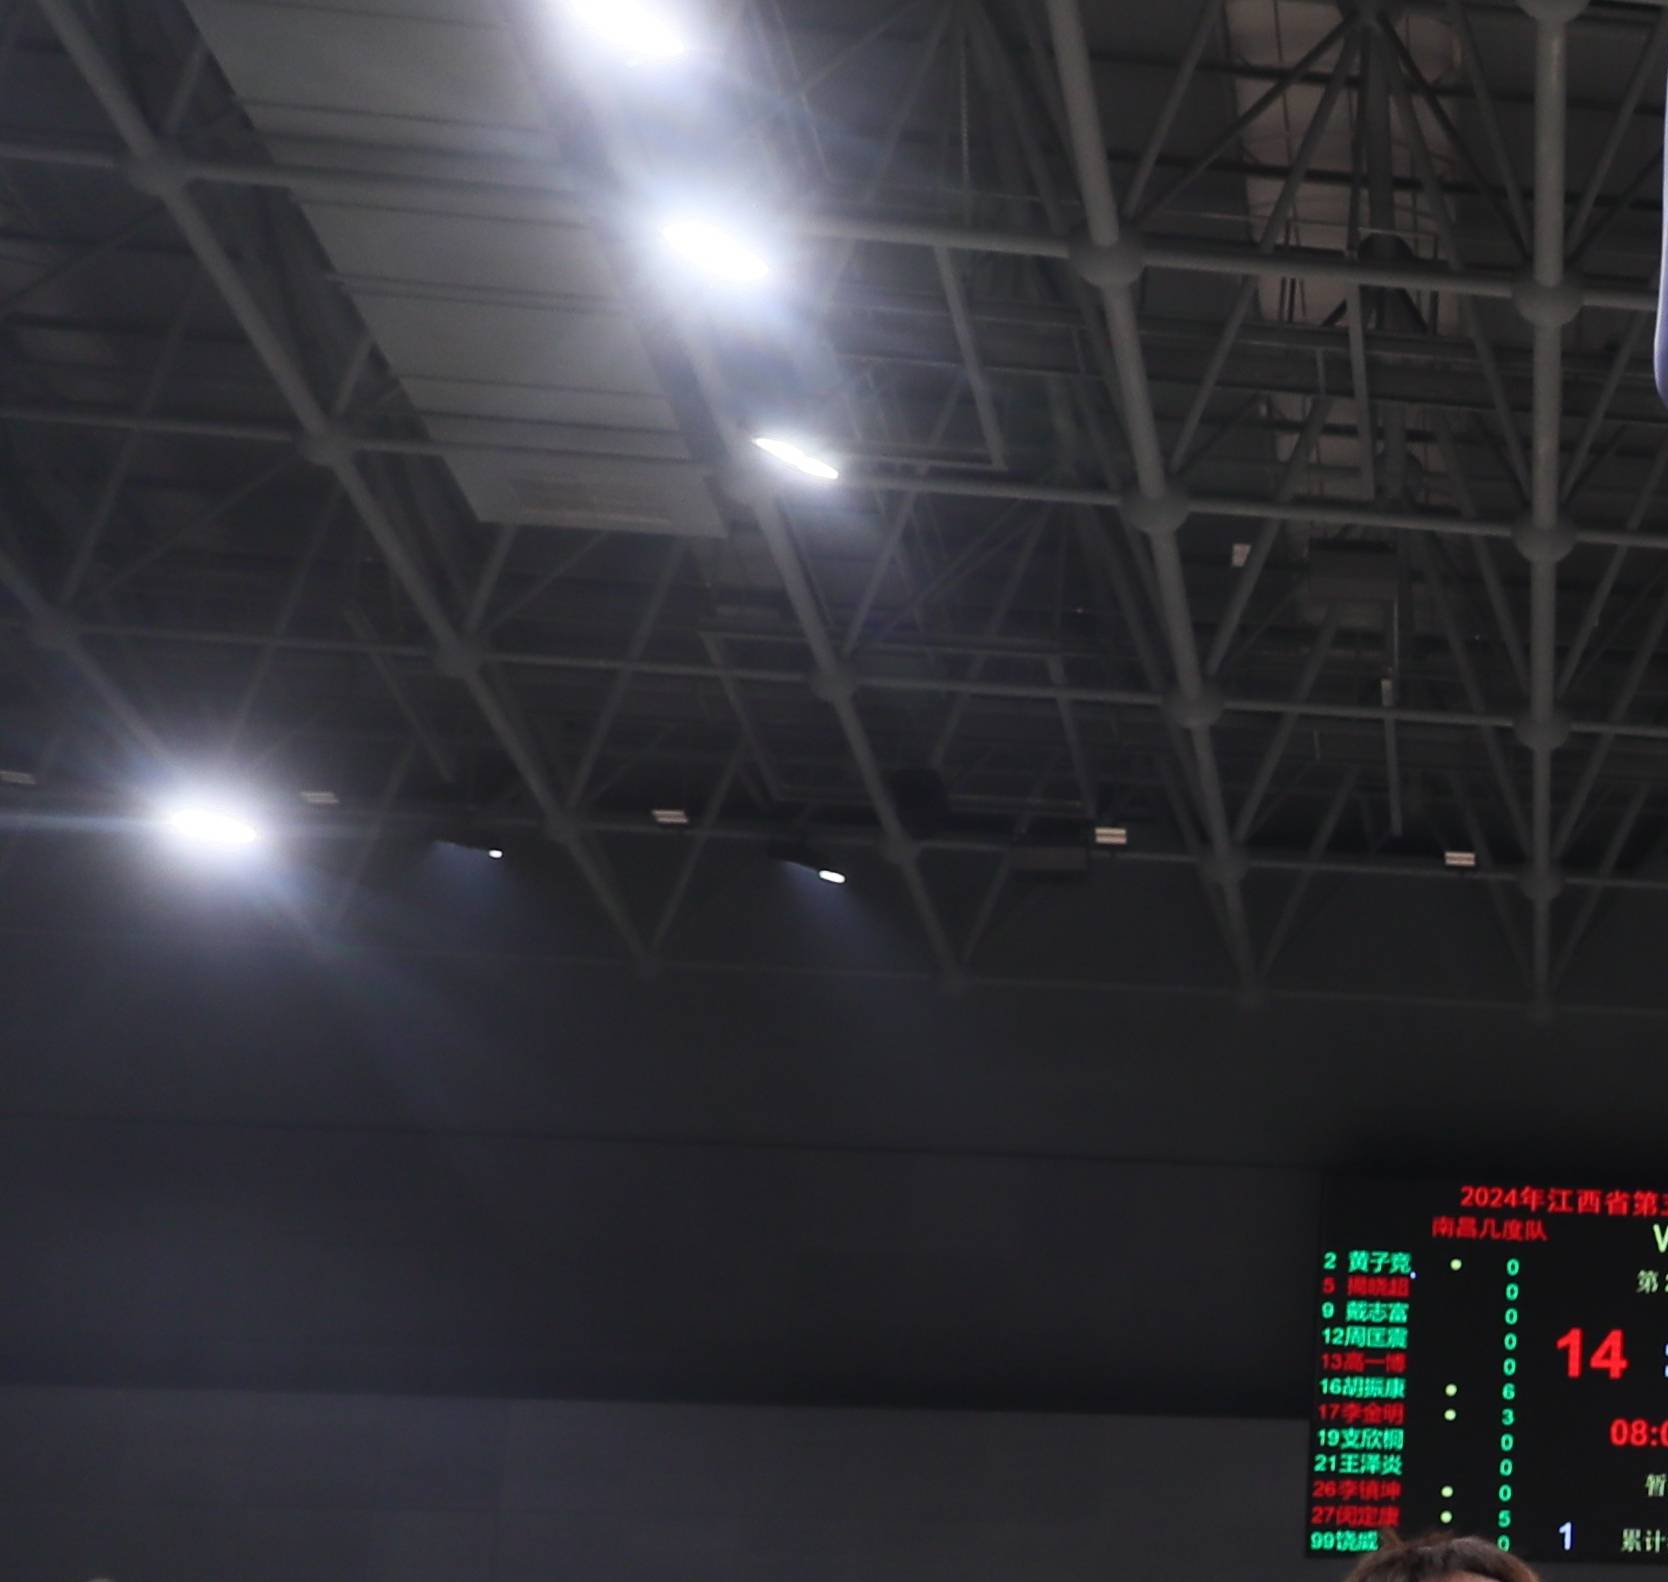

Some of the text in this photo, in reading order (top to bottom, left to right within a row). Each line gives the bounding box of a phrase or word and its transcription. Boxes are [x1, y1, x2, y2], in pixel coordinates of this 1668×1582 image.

[1431, 1216, 1548, 1242] 南昌几度队
[1323, 1252, 1337, 1270] 2
[1507, 1259, 1520, 1277] 0
[1506, 1283, 1519, 1301] 0
[1505, 1308, 1518, 1326] 0
[1504, 1333, 1517, 1351] 0
[1556, 1328, 1628, 1380] 14
[1503, 1358, 1516, 1376] 0
[1502, 1383, 1515, 1401] 6
[1501, 1408, 1515, 1426] 3
[1500, 1433, 1514, 1452] 0
[1500, 1459, 1513, 1477] 0
[1499, 1484, 1512, 1502] 0
[1498, 1510, 1511, 1529] 5
[1497, 1535, 1510, 1553] 0
[1559, 1521, 1573, 1551] 1
